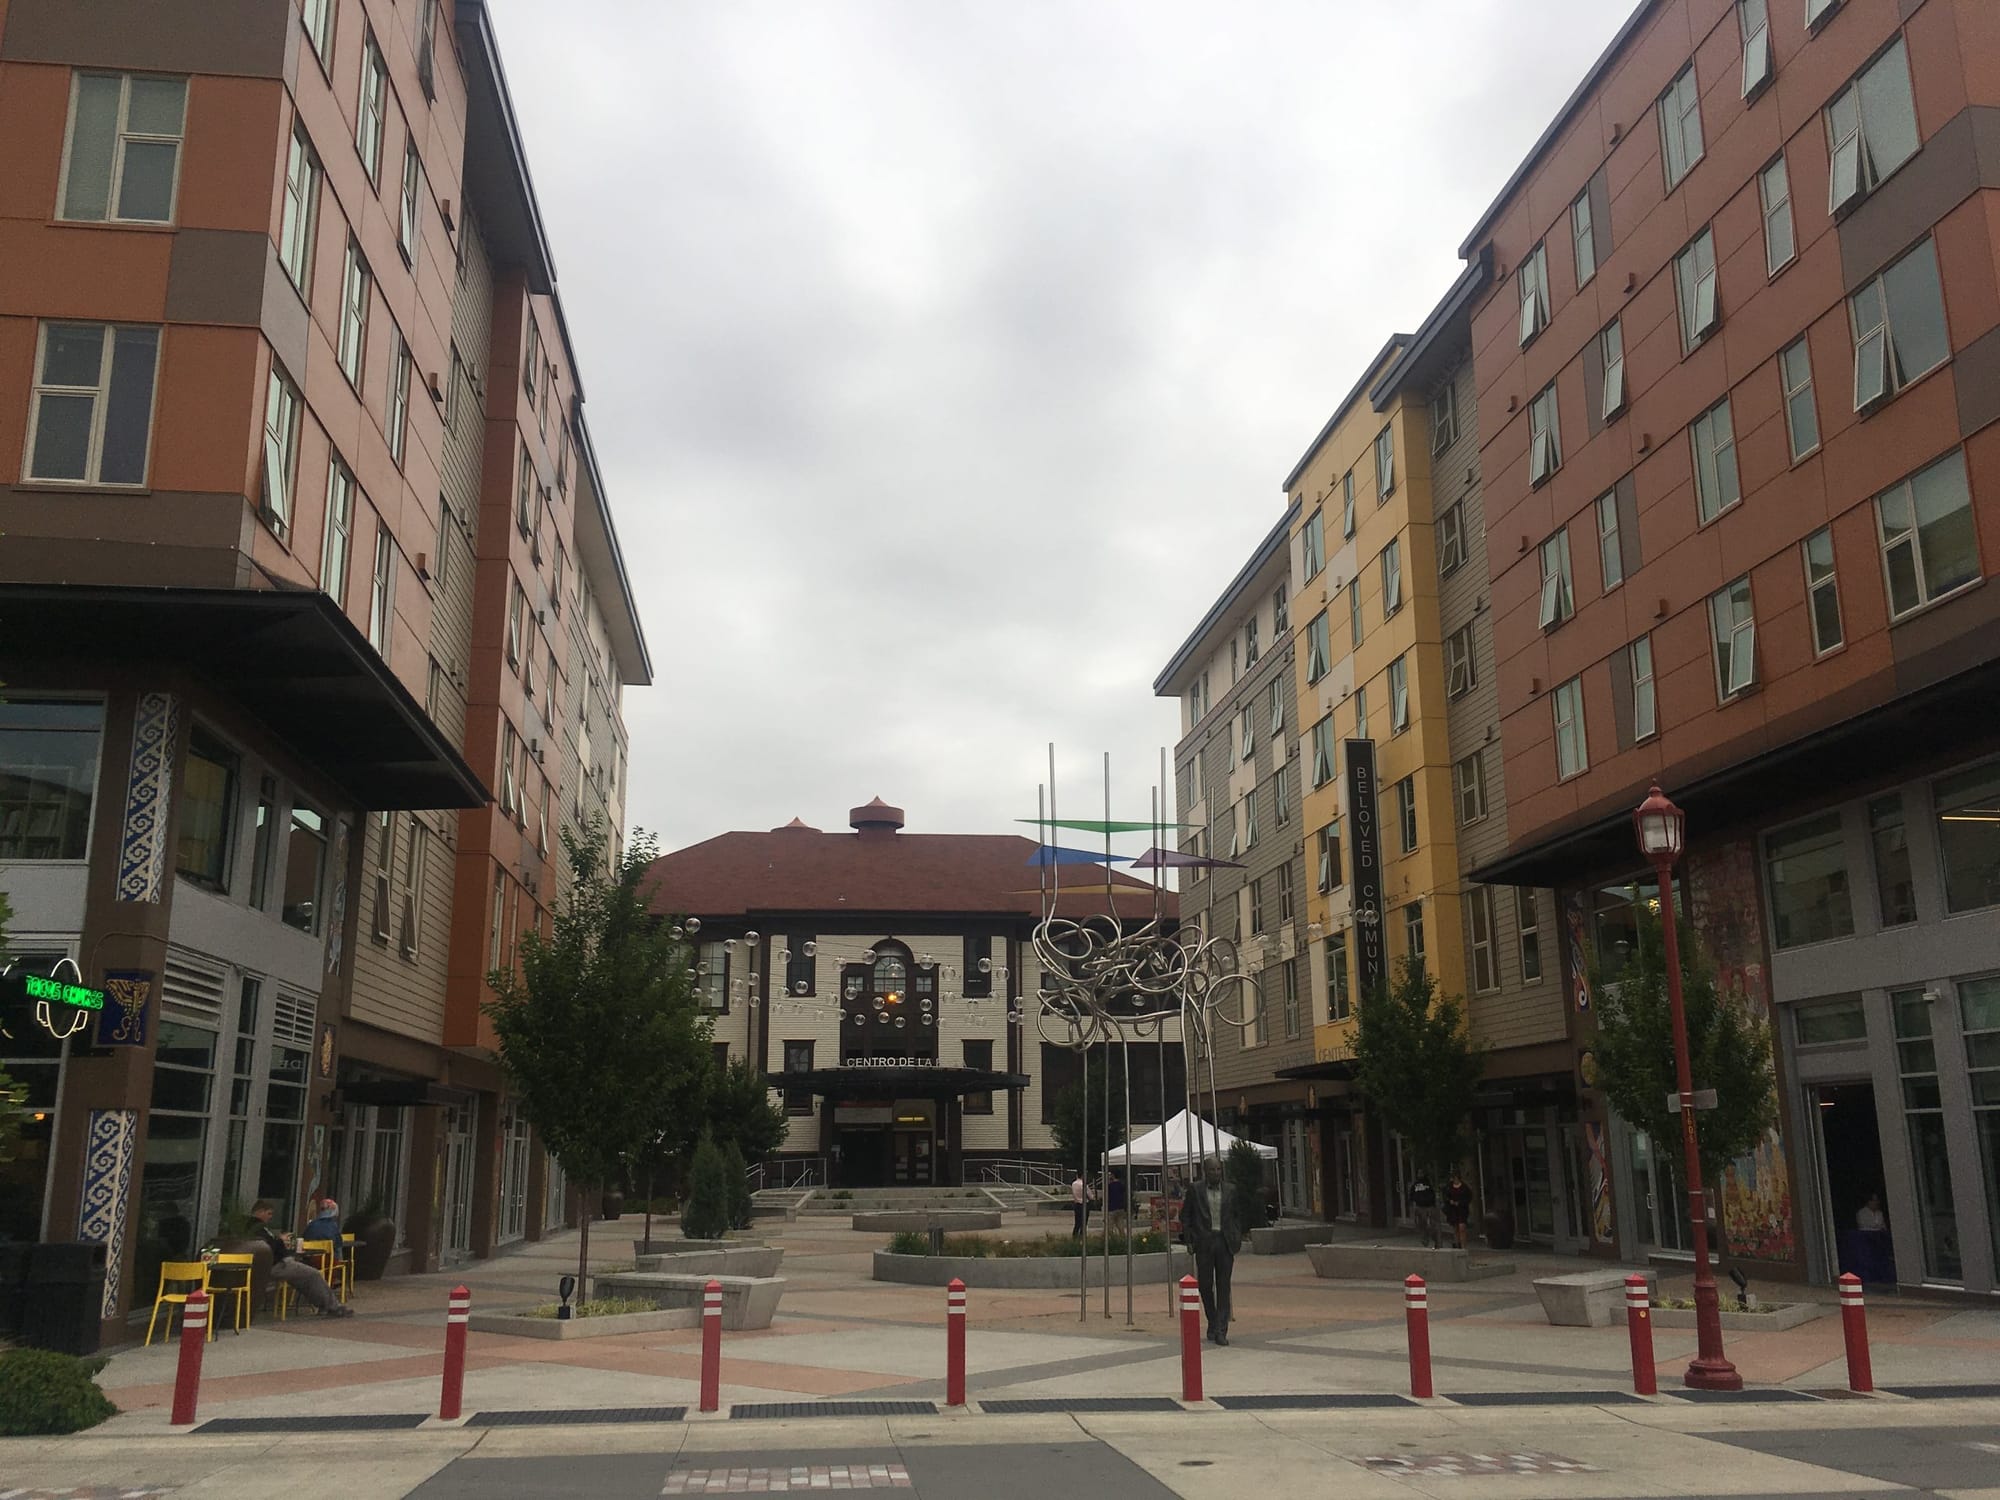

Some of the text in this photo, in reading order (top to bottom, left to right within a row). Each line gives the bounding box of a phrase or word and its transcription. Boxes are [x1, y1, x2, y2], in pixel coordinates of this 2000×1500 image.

[1357, 767, 1372, 867] BELOVED
[26, 975, 61, 1000] TACOS
[846, 1057, 896, 1068] CENTRO
[899, 1057, 915, 1068] DE
[918, 1058, 933, 1068] LA
